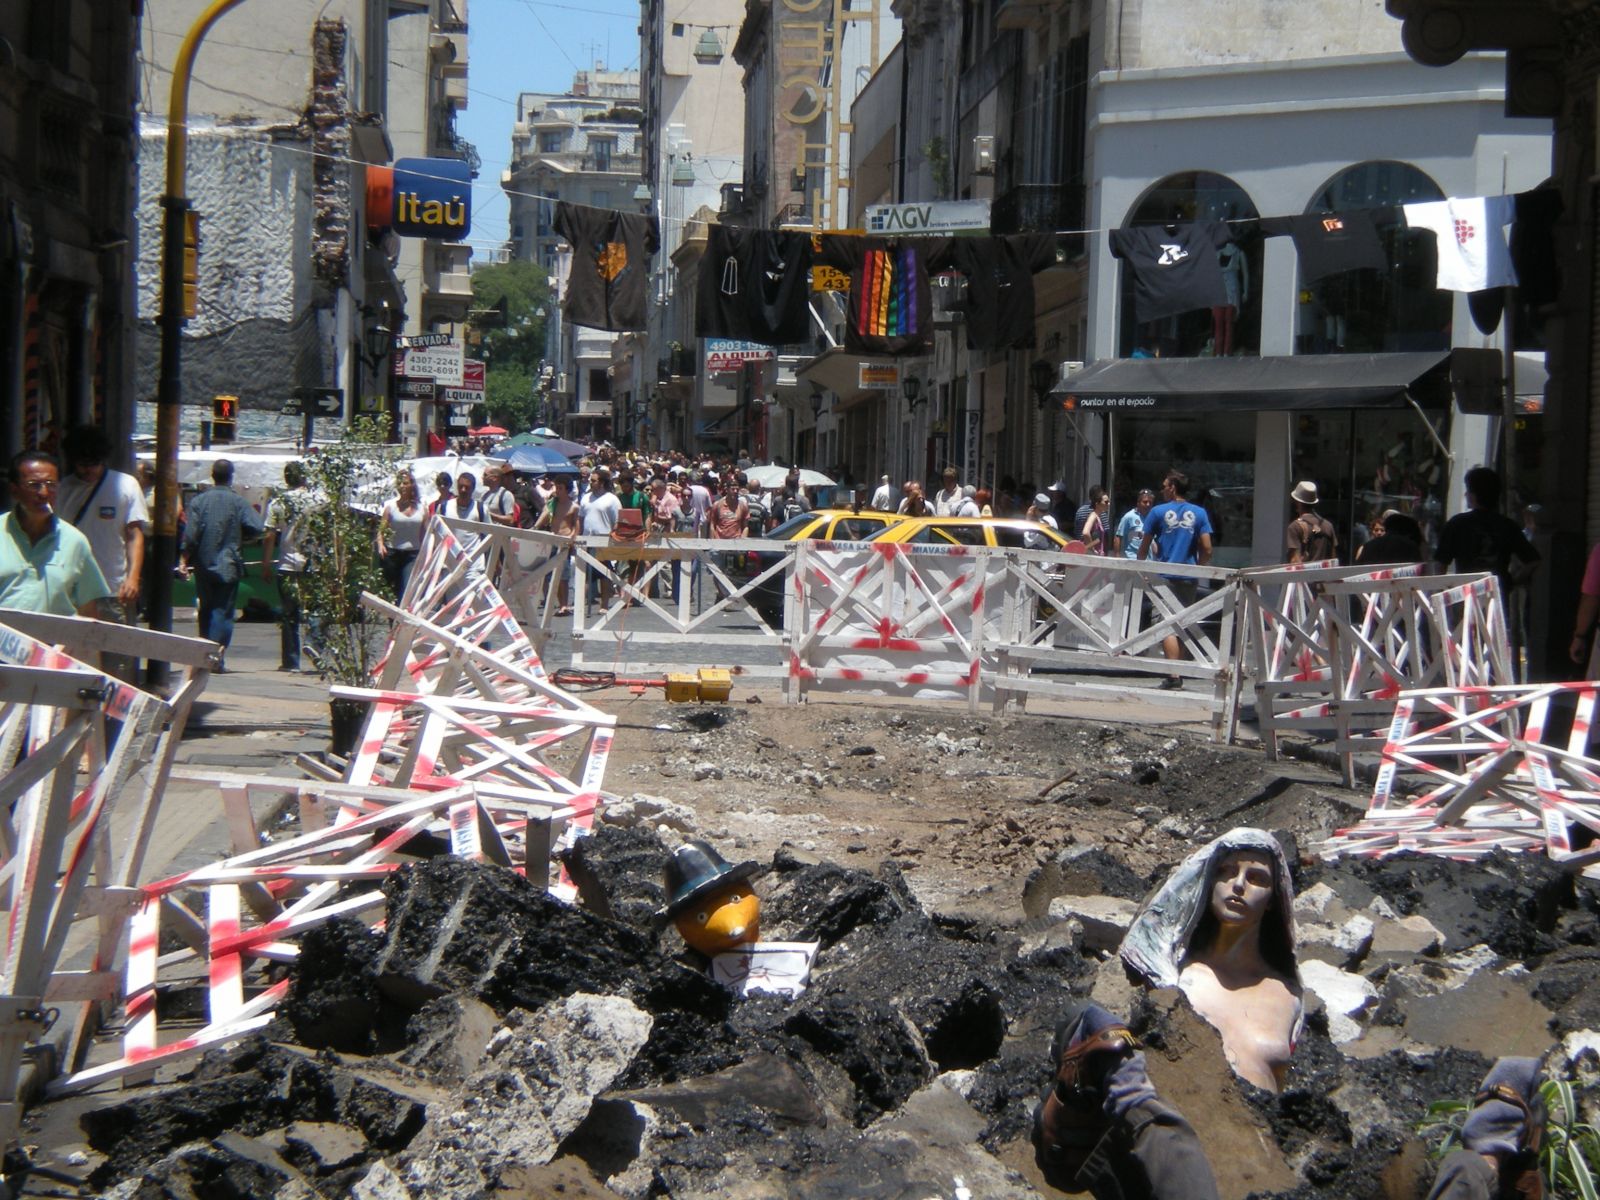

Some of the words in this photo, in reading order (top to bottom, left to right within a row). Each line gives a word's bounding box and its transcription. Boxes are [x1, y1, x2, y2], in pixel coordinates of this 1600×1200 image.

[399, 192, 465, 226] Itaú
[886, 206, 932, 229] AGV
[396, 335, 448, 348] RSERVADO
[710, 351, 774, 361] ALQUILA
